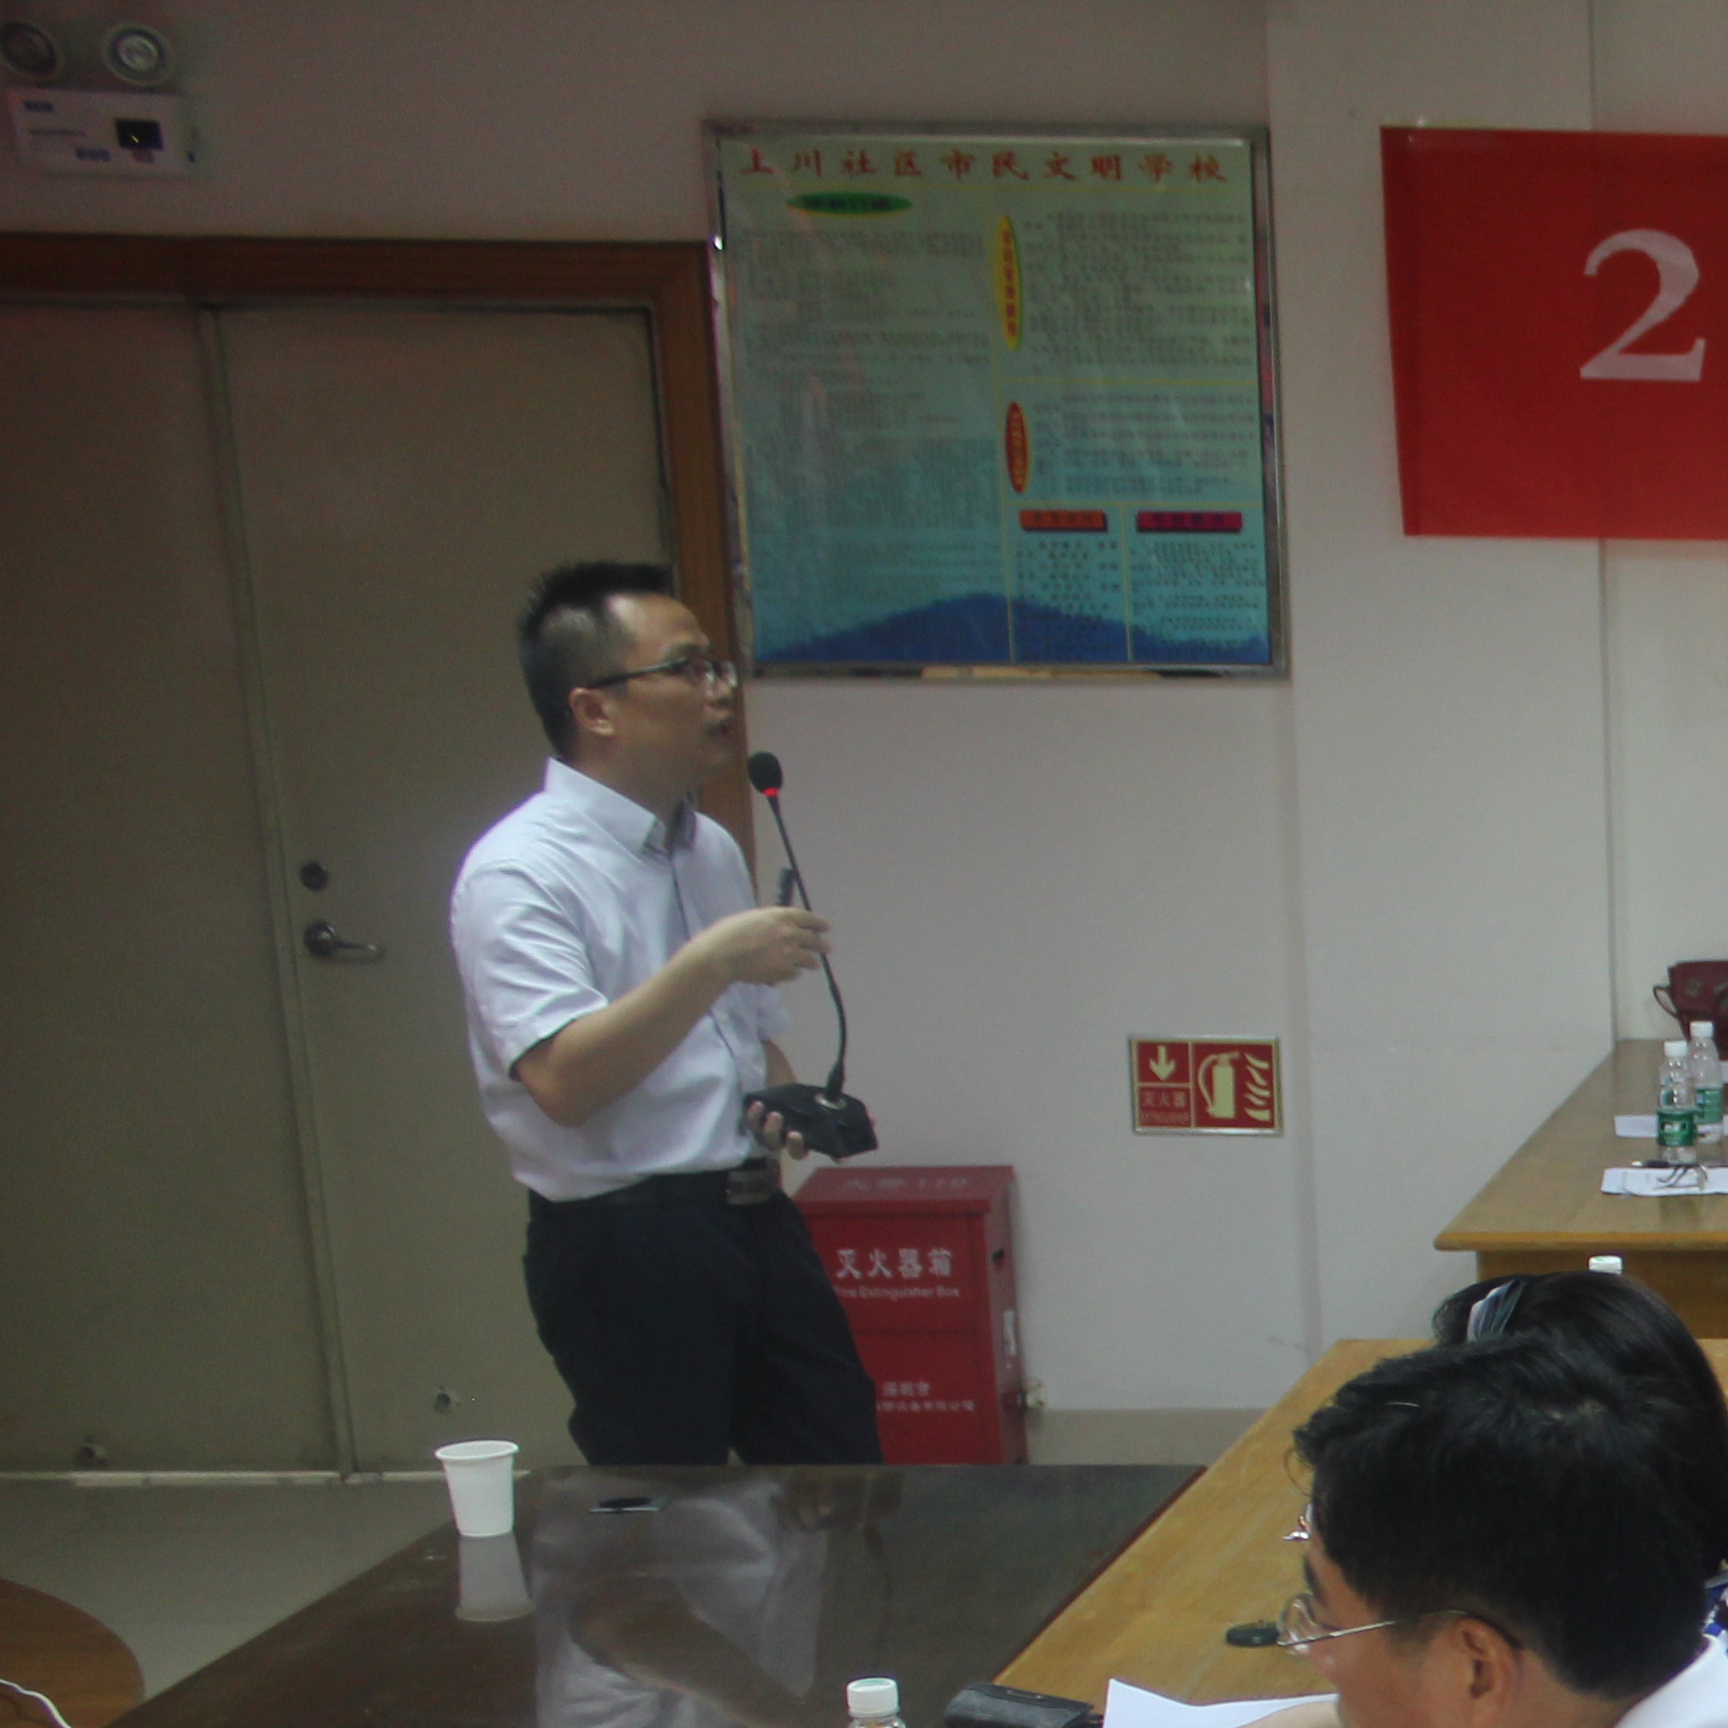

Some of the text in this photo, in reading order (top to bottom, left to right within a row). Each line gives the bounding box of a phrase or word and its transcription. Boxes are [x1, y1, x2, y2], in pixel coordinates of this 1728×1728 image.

[739, 147, 1228, 182] 上川社区市民文明学校
[836, 1248, 952, 1280] 灭火器箱
